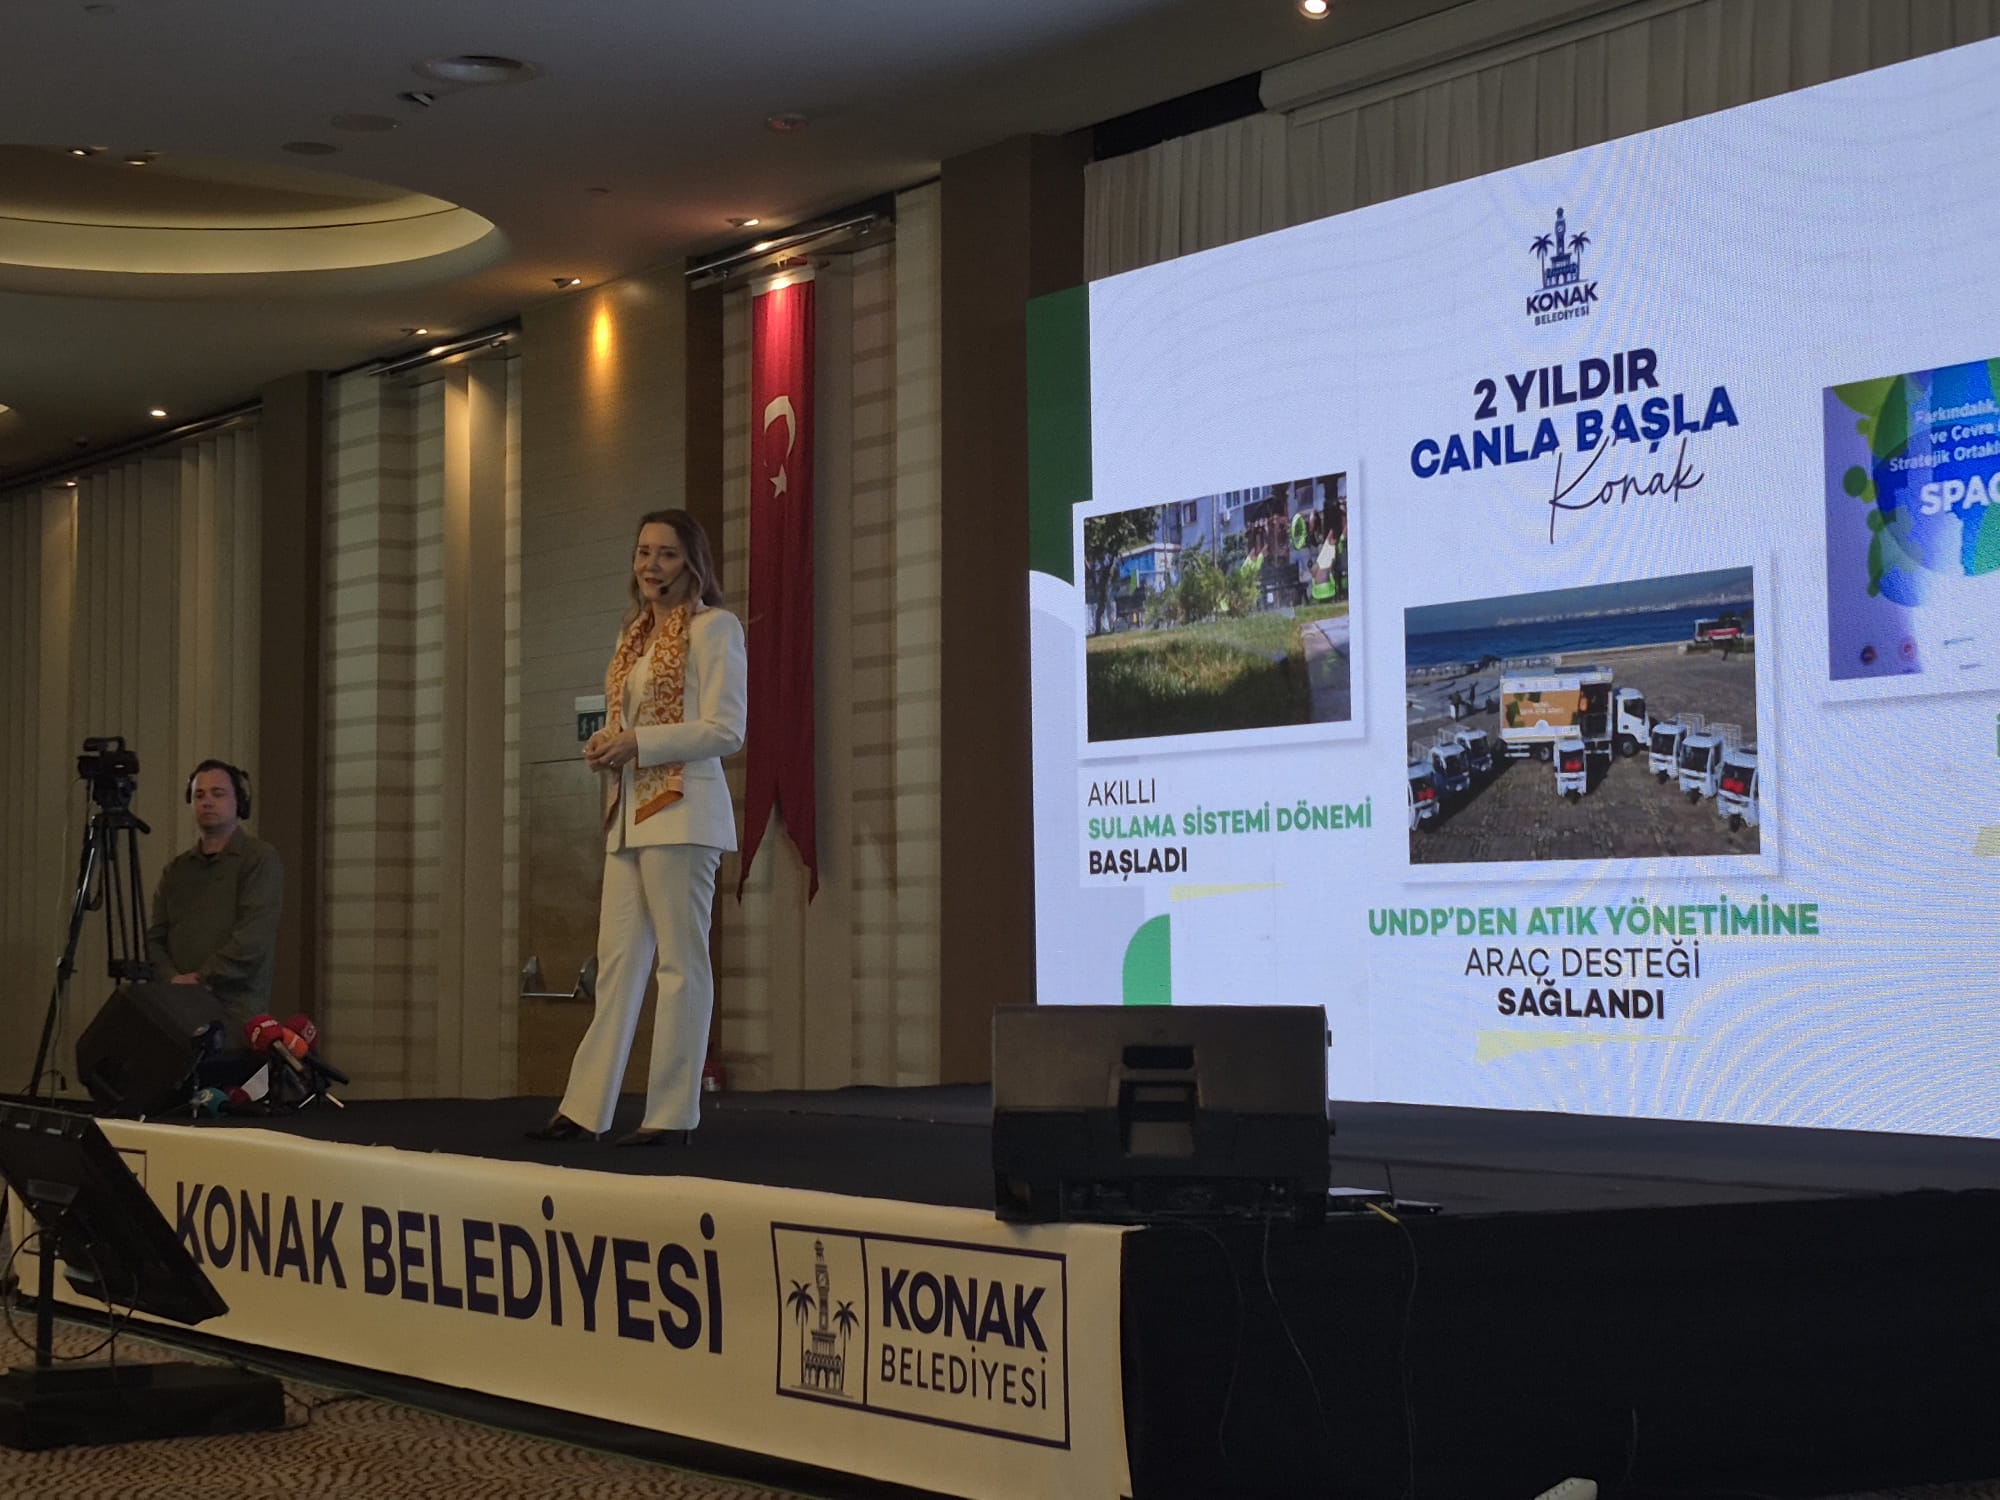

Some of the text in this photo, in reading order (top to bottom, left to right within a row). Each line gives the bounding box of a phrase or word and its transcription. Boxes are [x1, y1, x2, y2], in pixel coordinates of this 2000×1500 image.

[1526, 281, 1599, 316] KONAK
[1473, 348, 1659, 421] 2 YILDIR
[1411, 386, 1739, 478] CANLA BAŞLA
[1929, 431, 1948, 444] ve
[1889, 449, 1950, 473] Stratejik
[1548, 434, 1705, 545] Konak
[1087, 778, 1156, 807] AKILLI
[1088, 795, 1372, 840] SULAMA SİSTEMİ DÖNEMİ
[1089, 846, 1188, 881] BAŞLADI
[1526, 905, 1597, 936] ATIK
[1604, 894, 1820, 936] YÖNETİMİNE
[1465, 940, 1701, 985] ARAÇ DESTEĞİ
[1497, 979, 1665, 1020] SAĞLANDI
[176, 1180, 723, 1355] KONAK BELEDİYESİ
[880, 1266, 1048, 1353] KONAK
[881, 1343, 1047, 1411] BELEDİYESİ
